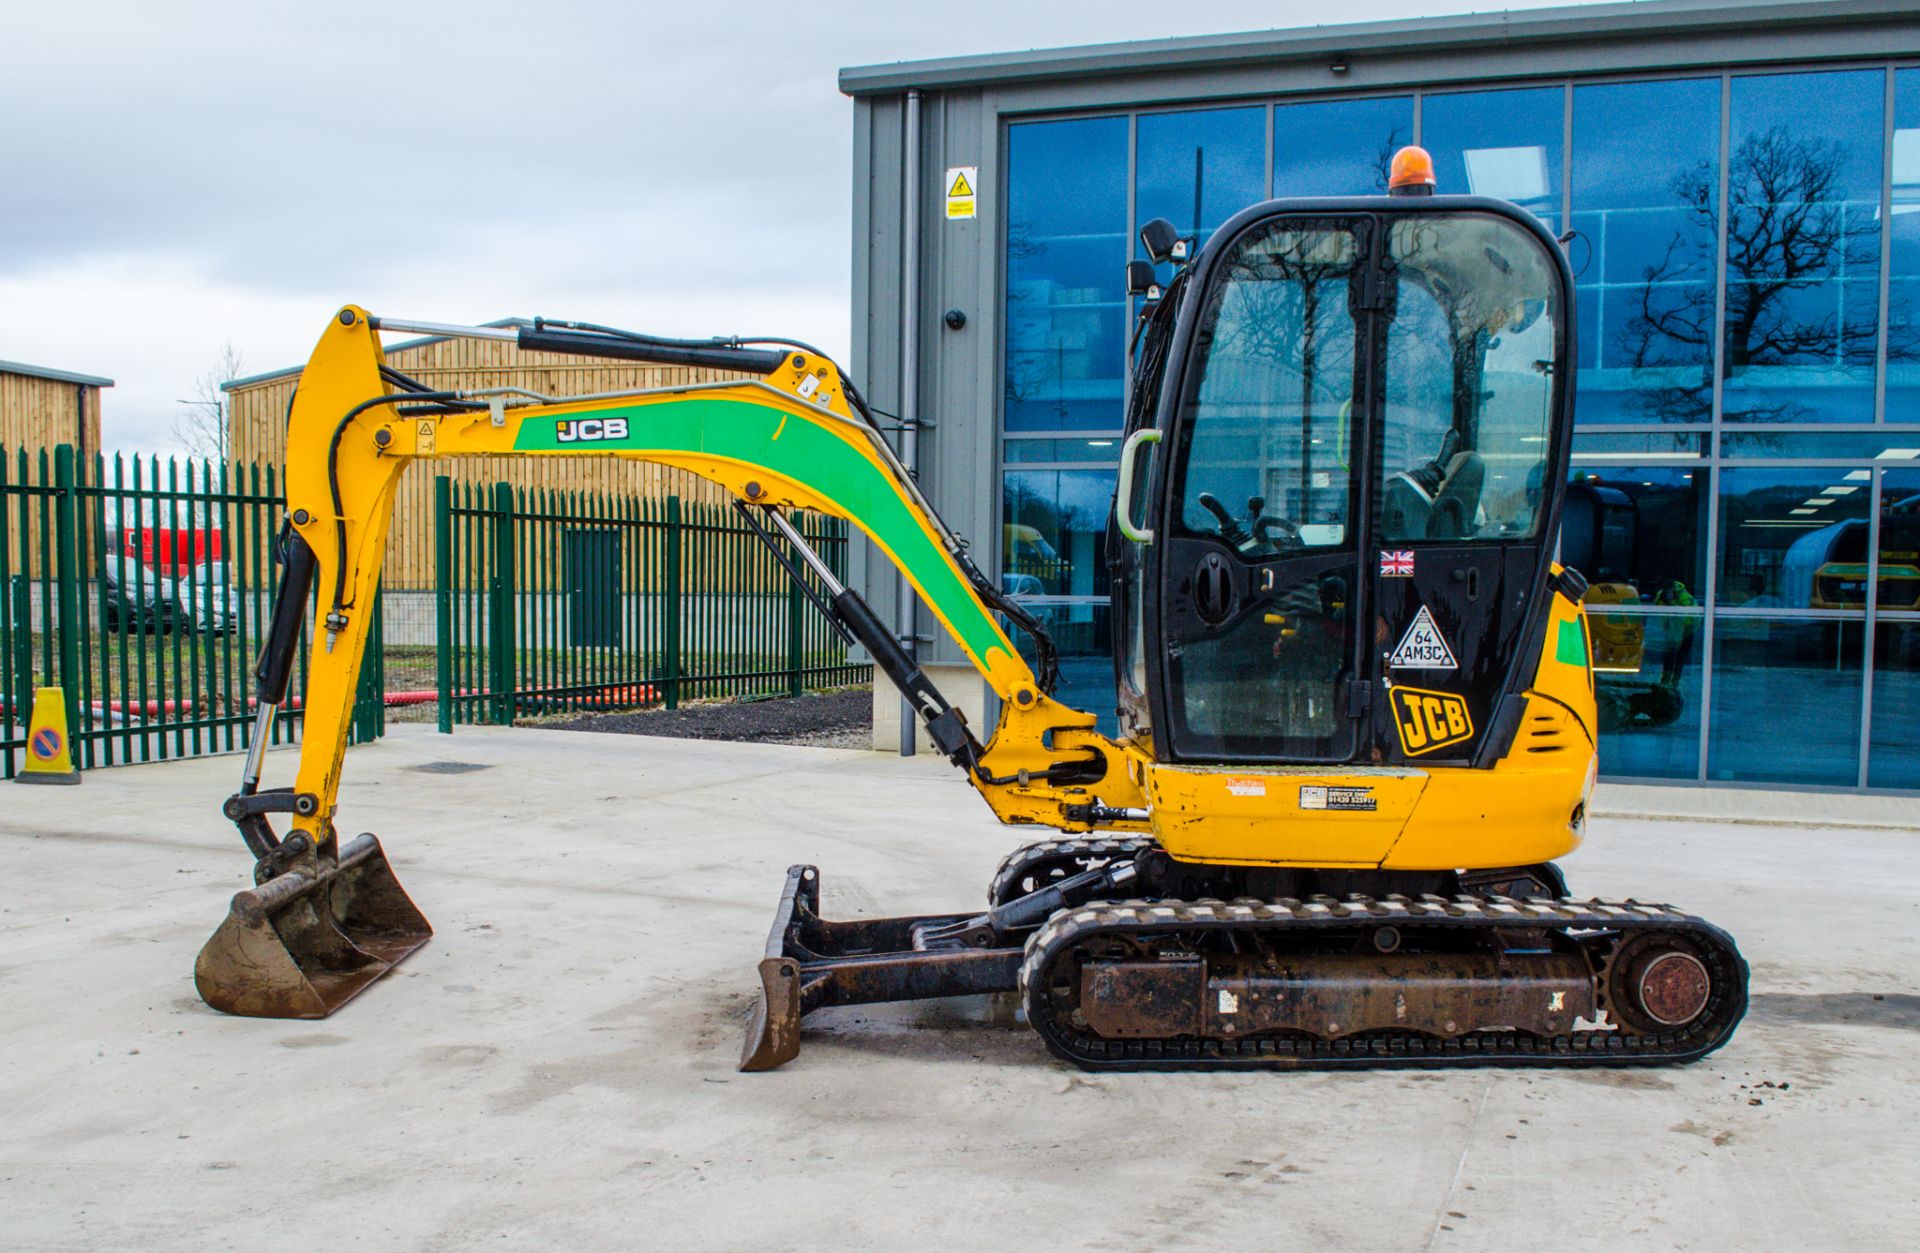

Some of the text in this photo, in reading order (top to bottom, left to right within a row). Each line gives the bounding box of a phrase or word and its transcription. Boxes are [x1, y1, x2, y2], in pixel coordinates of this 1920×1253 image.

[557, 419, 628, 441] JCB
[1415, 631, 1432, 644] 64
[1405, 646, 1443, 660] AM3C
[1402, 694, 1467, 748] JCB
